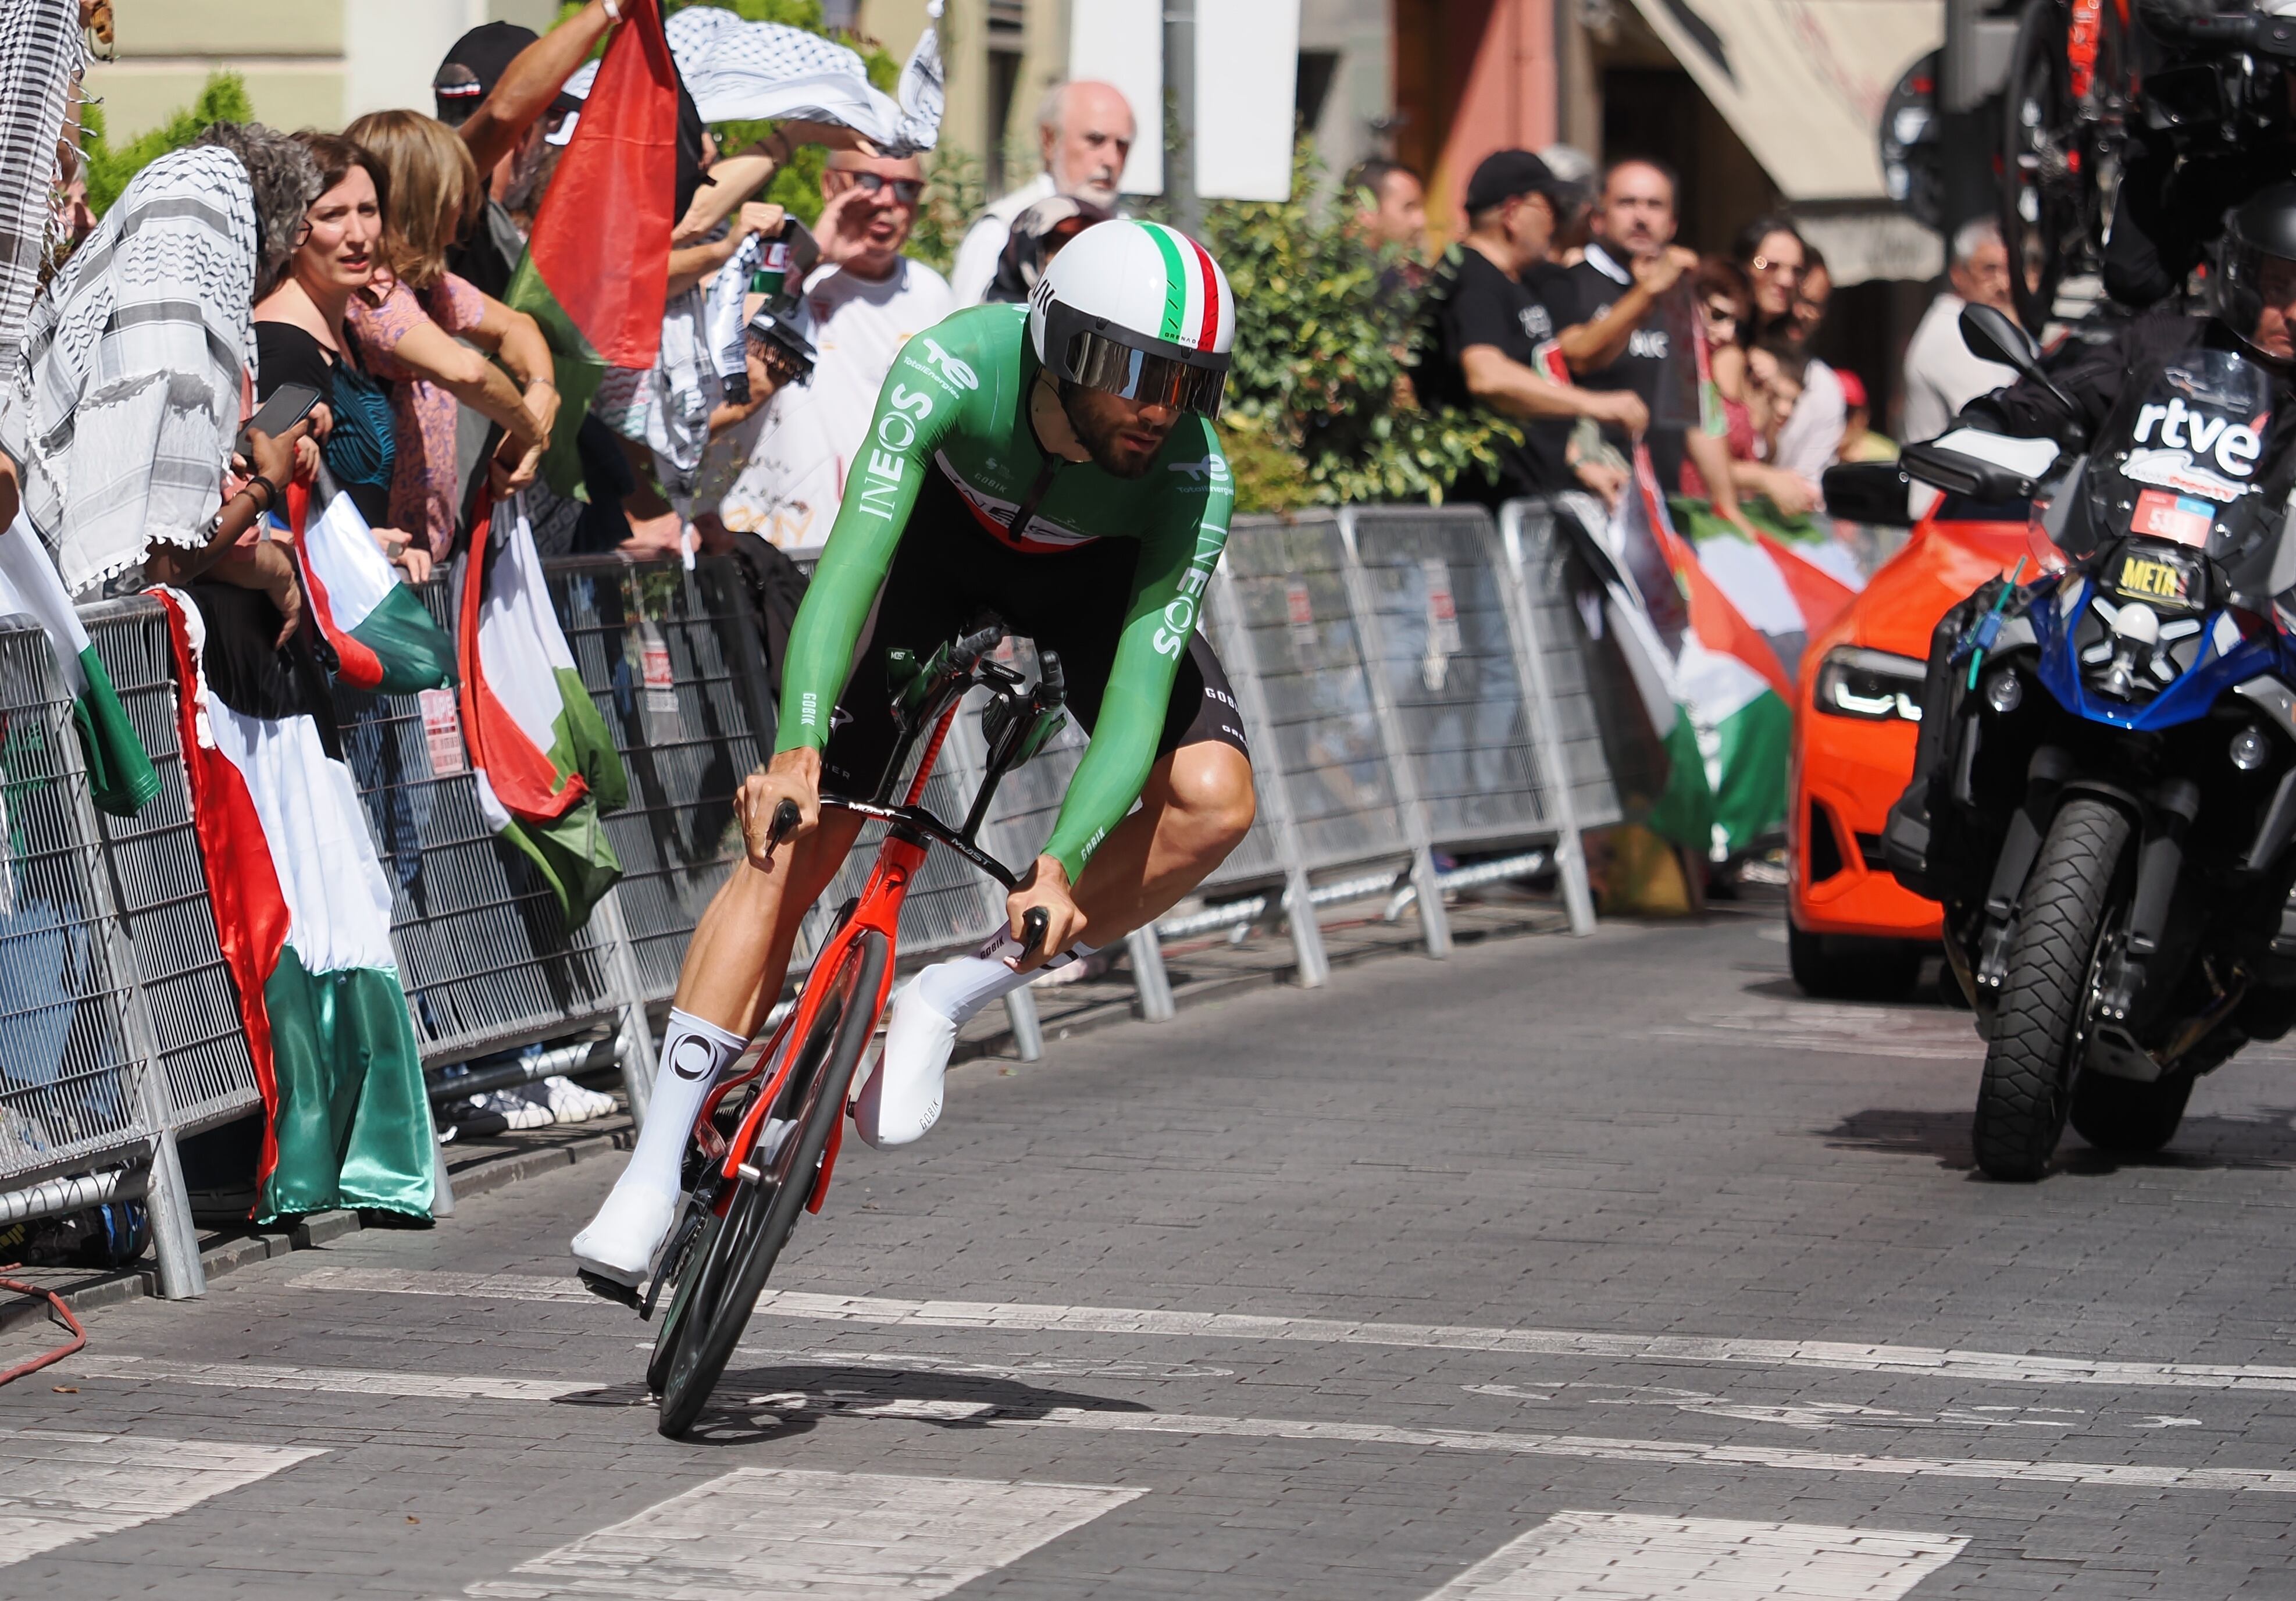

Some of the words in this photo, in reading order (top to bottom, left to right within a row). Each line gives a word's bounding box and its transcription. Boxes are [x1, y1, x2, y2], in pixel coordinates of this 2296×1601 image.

[903, 356, 960, 400] TotalEnergies
[859, 383, 933, 522] INEOS
[2133, 397, 2261, 476] rtve
[975, 473, 1007, 493] GOBIK
[1153, 523, 1228, 661] INEOS
[993, 666, 1015, 678] GARMIN
[801, 693, 817, 726] GOBIK
[1081, 826, 1105, 861] GOBIK
[980, 935, 1004, 960] GOBIK
[919, 1097, 939, 1130] GOBIK
